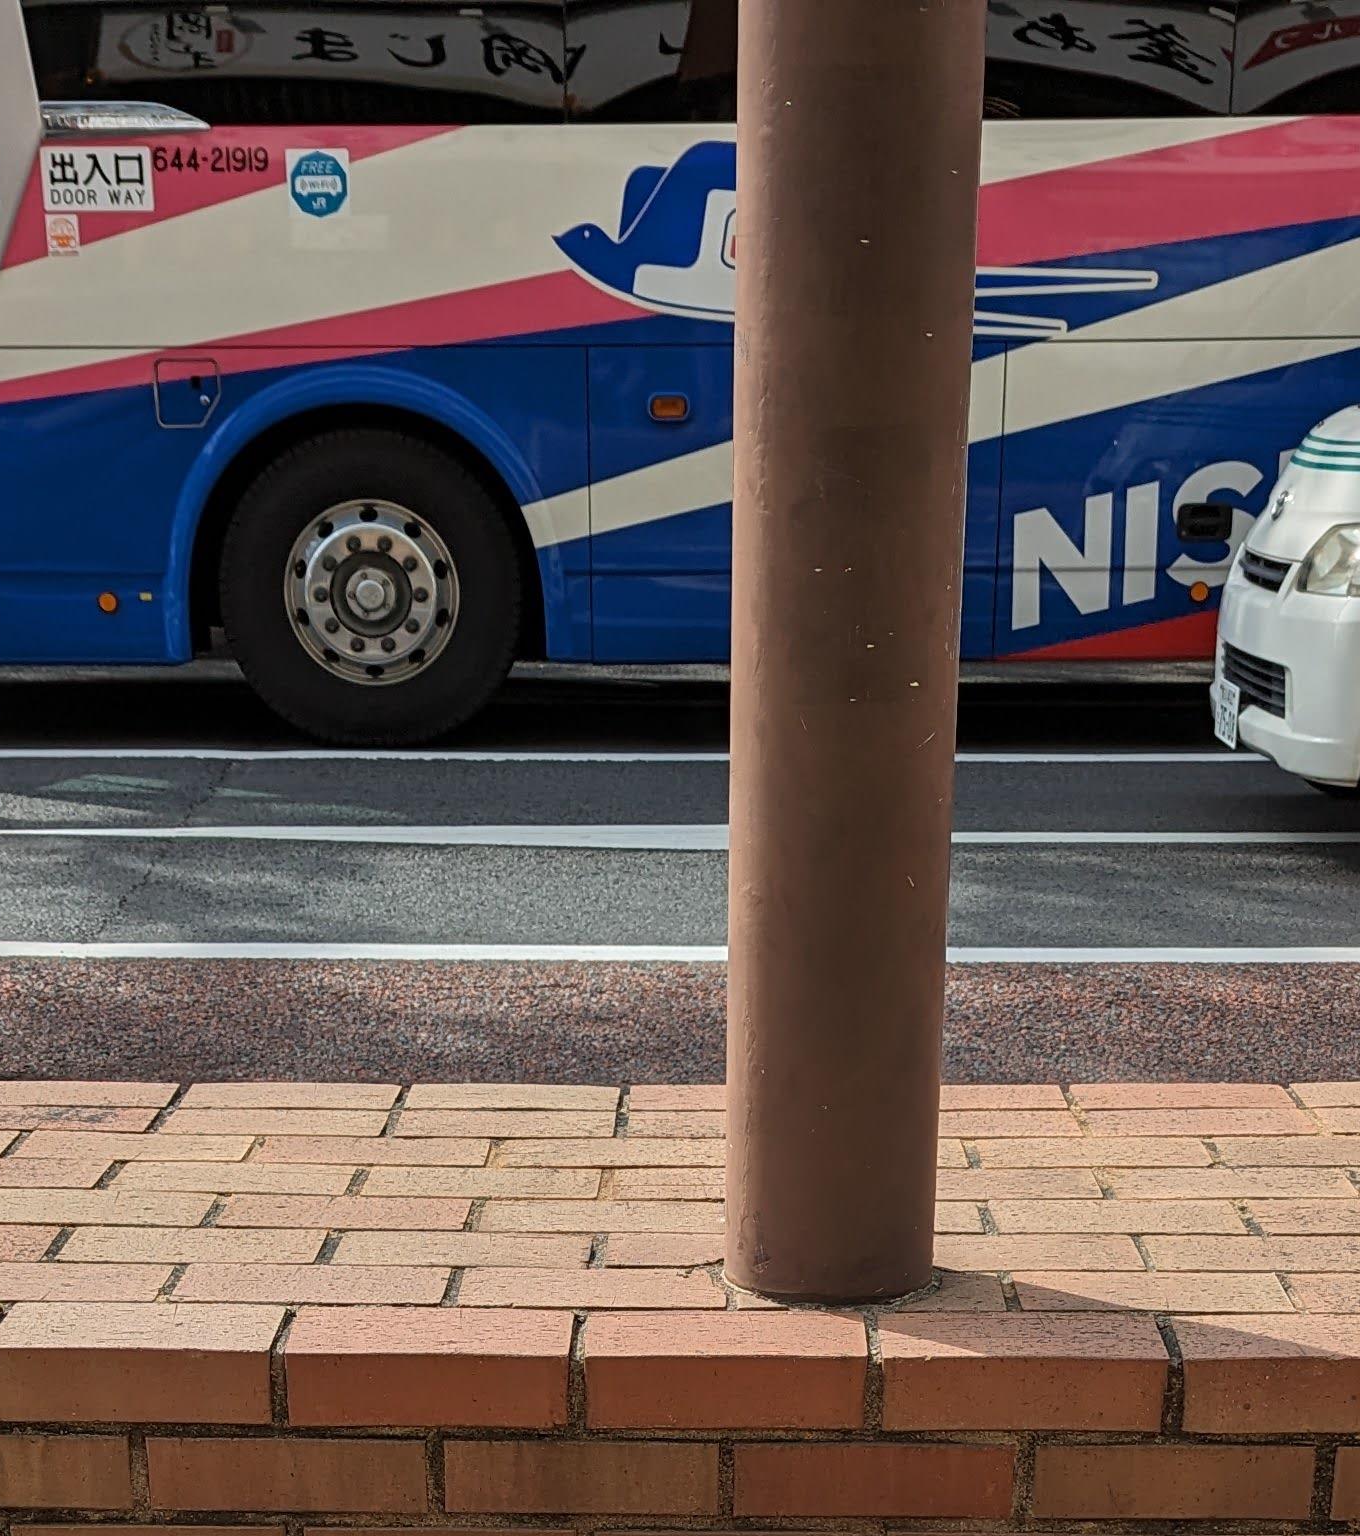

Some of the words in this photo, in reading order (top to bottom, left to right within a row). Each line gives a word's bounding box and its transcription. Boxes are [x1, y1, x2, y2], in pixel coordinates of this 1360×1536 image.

[49, 152, 144, 185] 出入口
[153, 147, 269, 172] 644-21919
[301, 160, 335, 174] FREE
[50, 189, 98, 205] DOOR
[108, 189, 146, 206] WAY
[311, 197, 327, 209] JR
[1011, 449, 1292, 631] NIS
